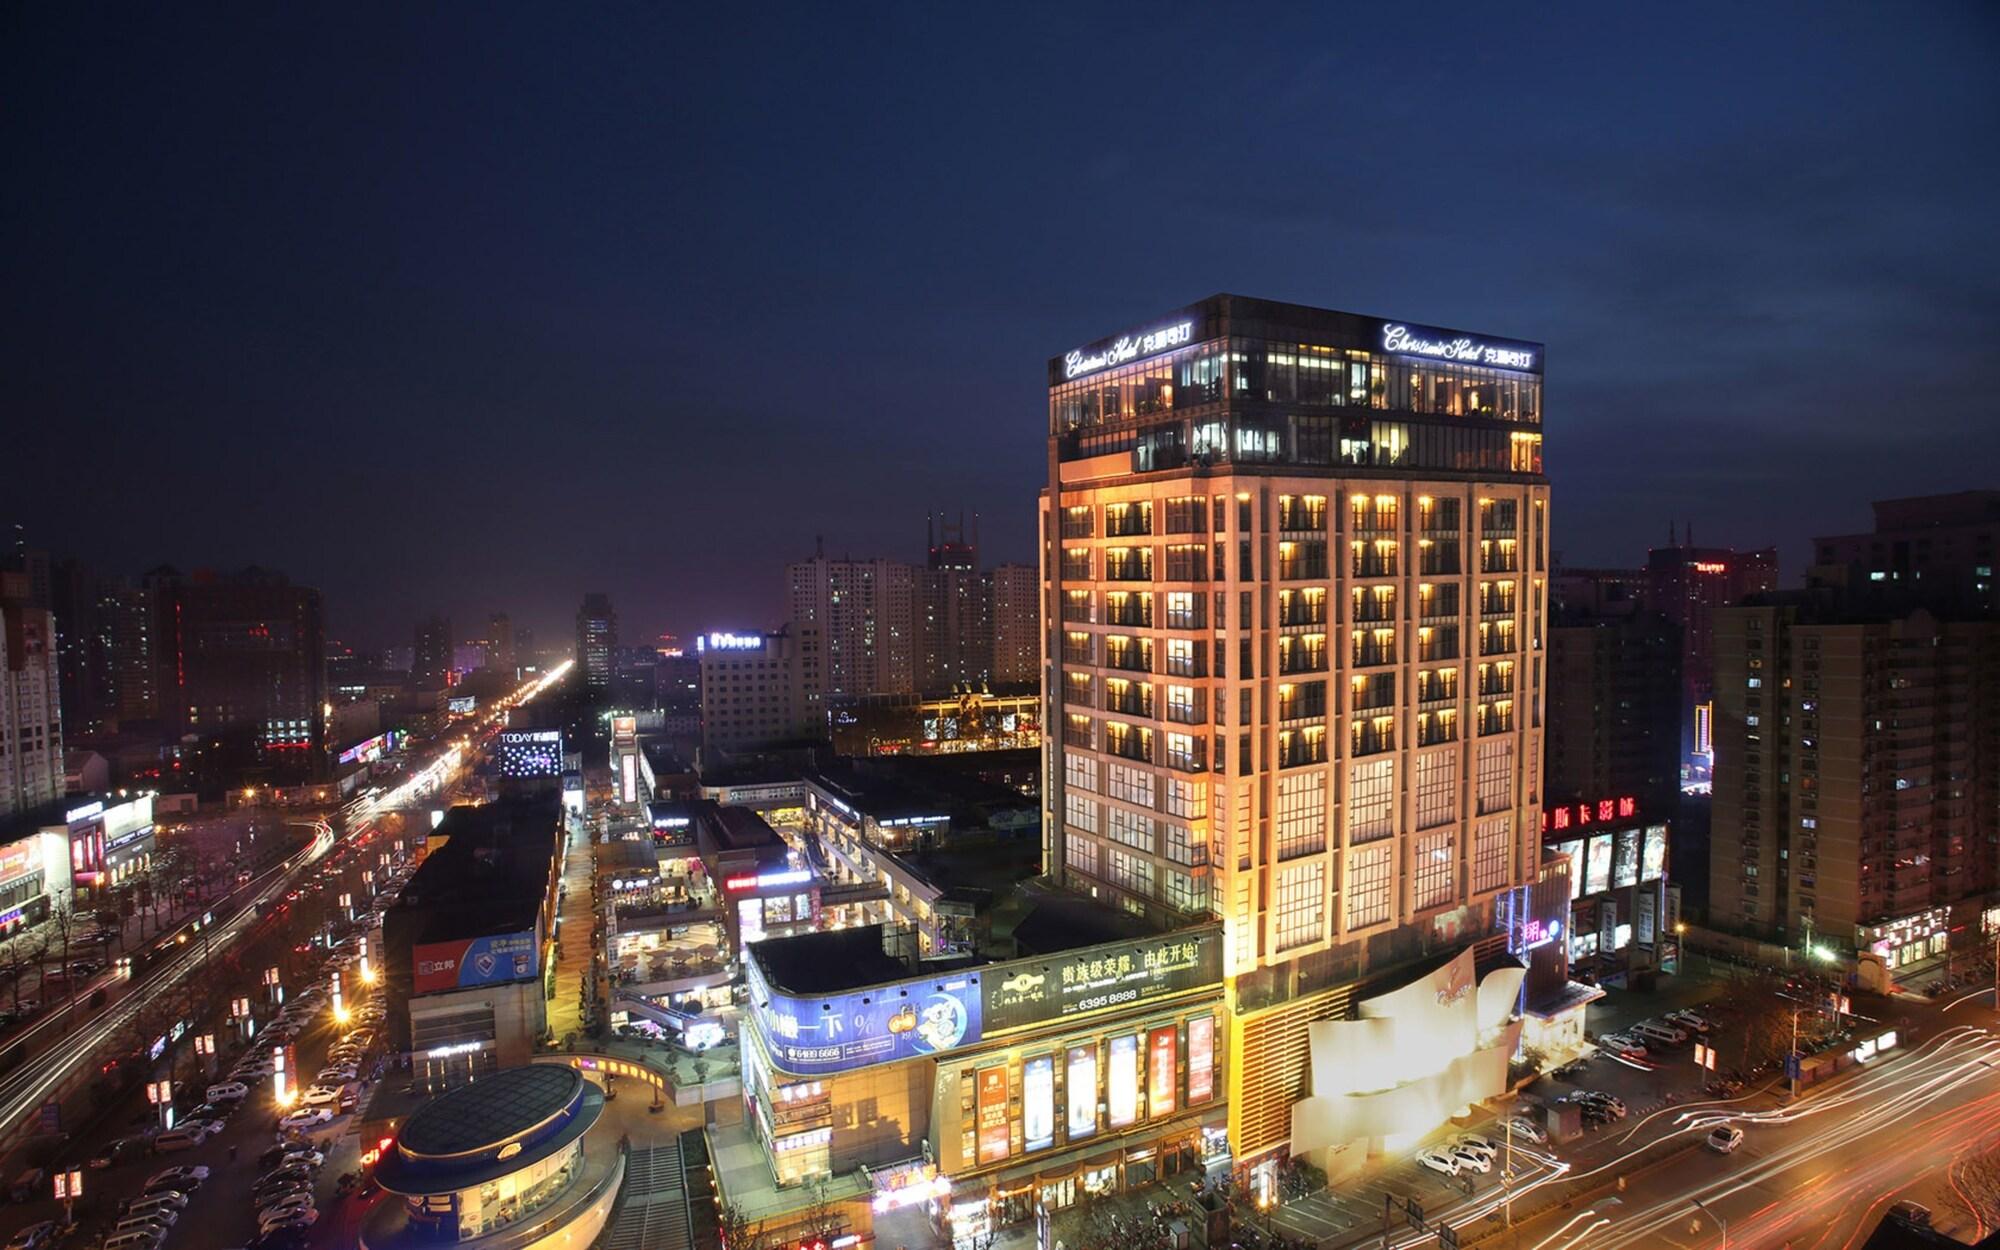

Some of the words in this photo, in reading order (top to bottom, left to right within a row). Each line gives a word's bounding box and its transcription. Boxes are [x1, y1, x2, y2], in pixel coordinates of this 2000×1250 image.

[1108, 336, 1142, 366] Hotel
[1444, 338, 1484, 361] Hotel
[501, 733, 532, 743] TODAY
[1079, 994, 1107, 1010] 6395
[1109, 989, 1137, 1004] 8888
